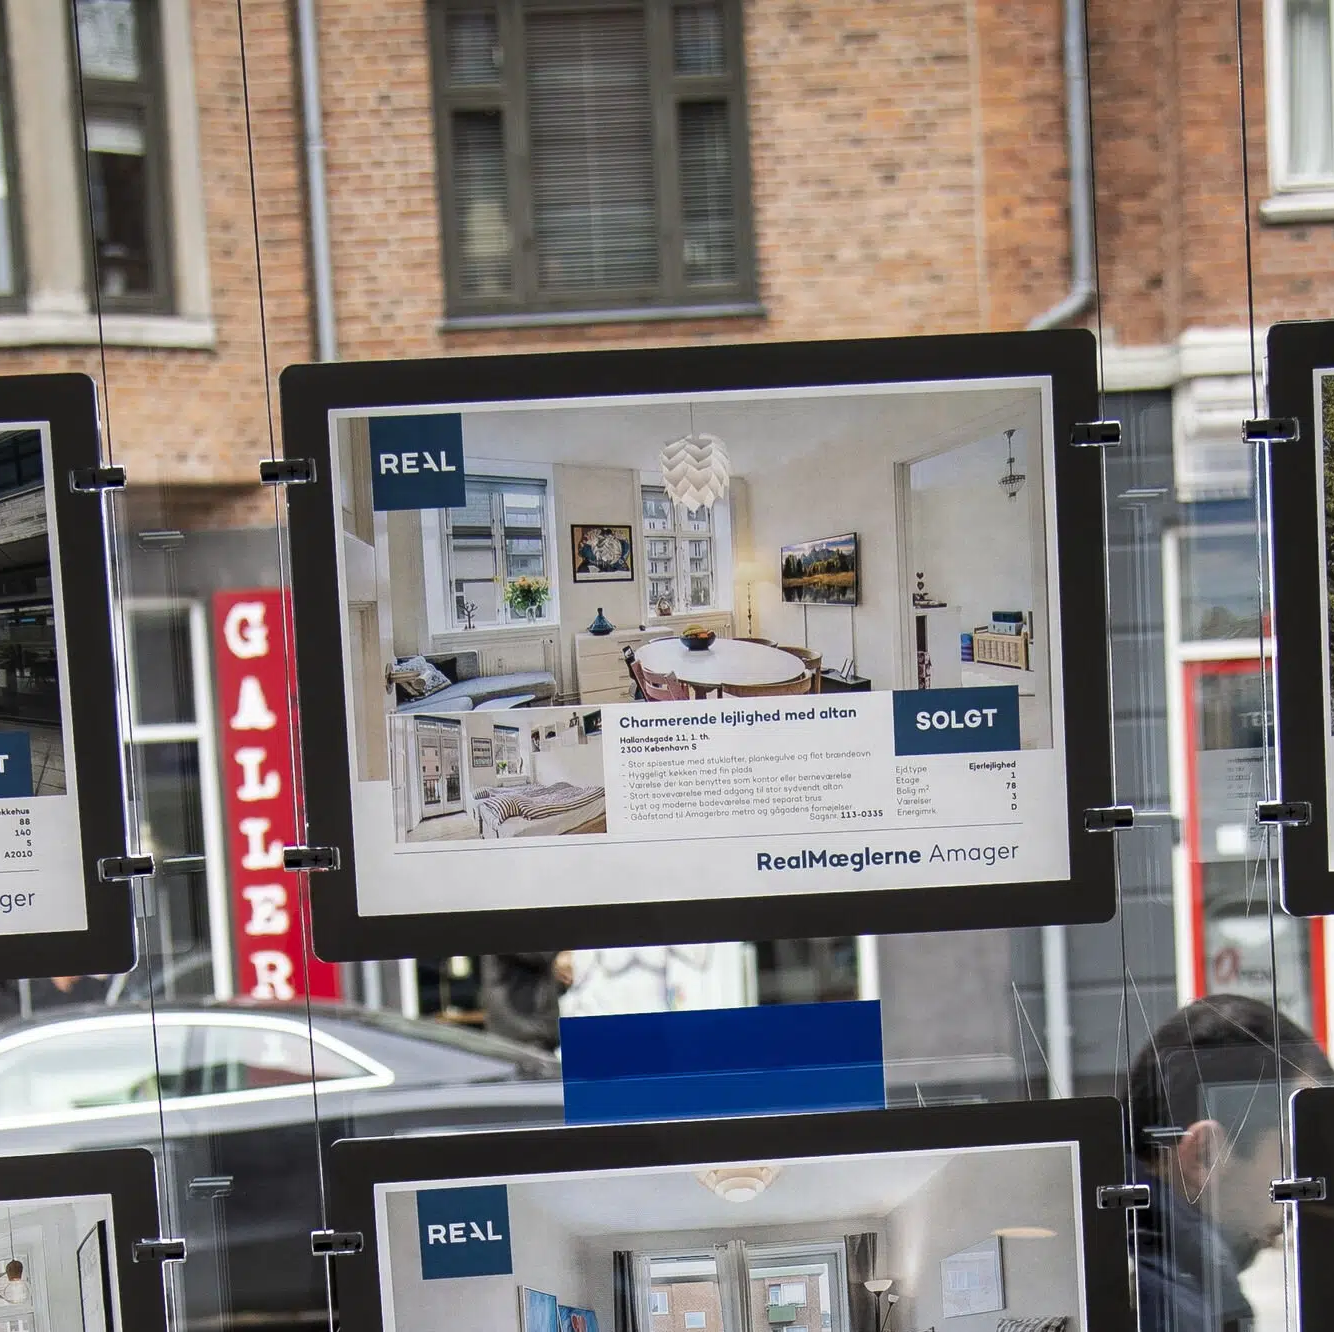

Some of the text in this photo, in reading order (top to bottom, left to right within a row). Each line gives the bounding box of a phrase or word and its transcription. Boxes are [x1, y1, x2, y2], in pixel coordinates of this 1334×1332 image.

[379, 450, 456, 475] REAL
[619, 706, 857, 728] Charmerende lejlighed med altan
[915, 708, 997, 730] SOLGT
[619, 734, 674, 745] Hallandsgade
[620, 745, 642, 754] 2300
[644, 743, 689, 752] København
[224, 602, 295, 1001] GALLER
[840, 809, 883, 819] 113-0335
[756, 843, 1019, 872] RealMæglerne Amager
[427, 1220, 503, 1245] REAL
